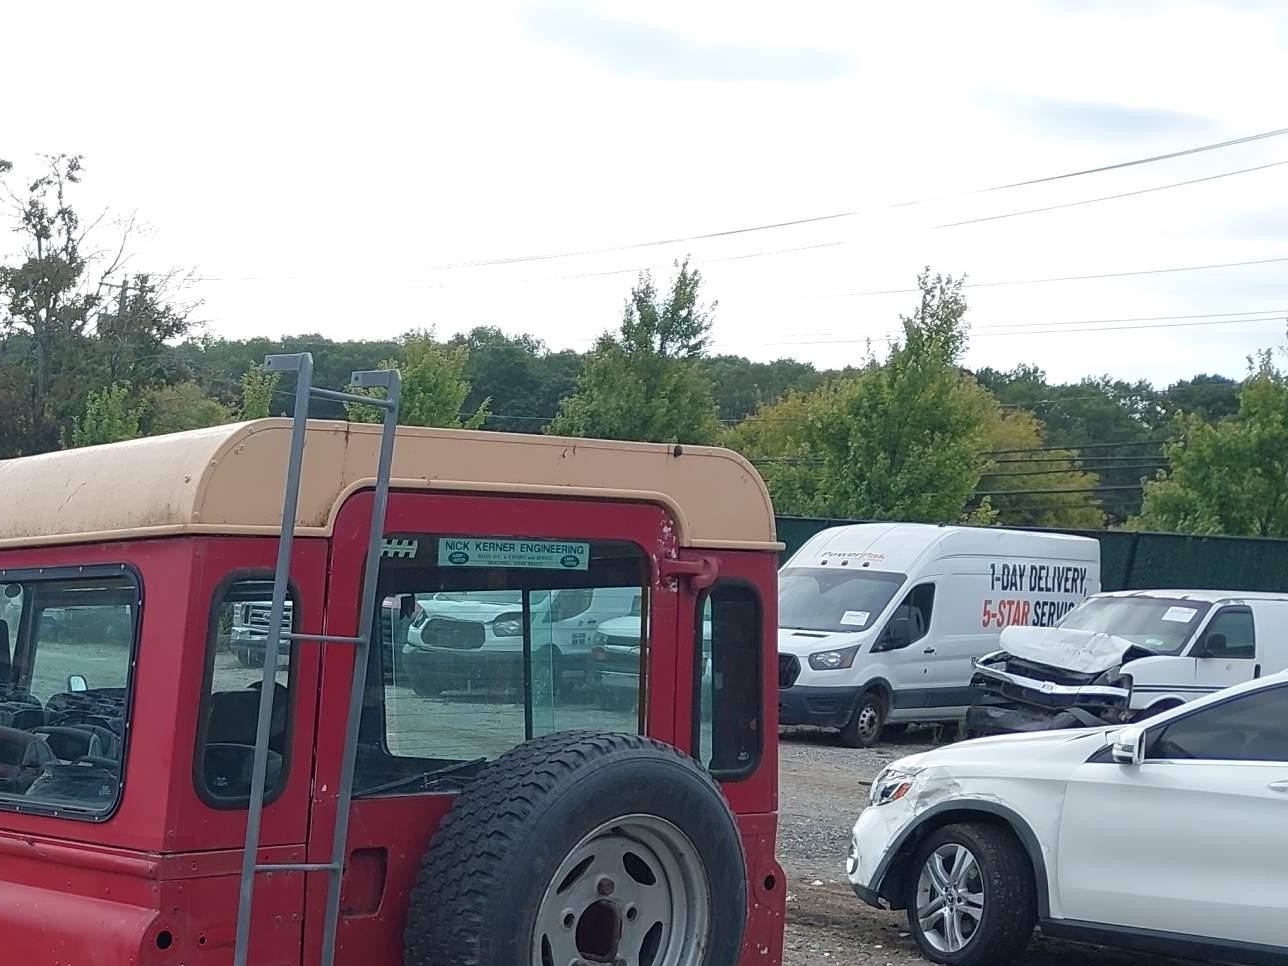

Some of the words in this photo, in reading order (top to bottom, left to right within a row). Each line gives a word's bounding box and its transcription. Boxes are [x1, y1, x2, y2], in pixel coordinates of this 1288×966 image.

[445, 541, 470, 551] NICK
[475, 543, 515, 552] KERNER
[520, 544, 584, 554] ENGINEERING
[990, 563, 1026, 592] 1-DAY
[1029, 564, 1087, 598] DELIVERY,
[982, 599, 1030, 628] 5-STAR
